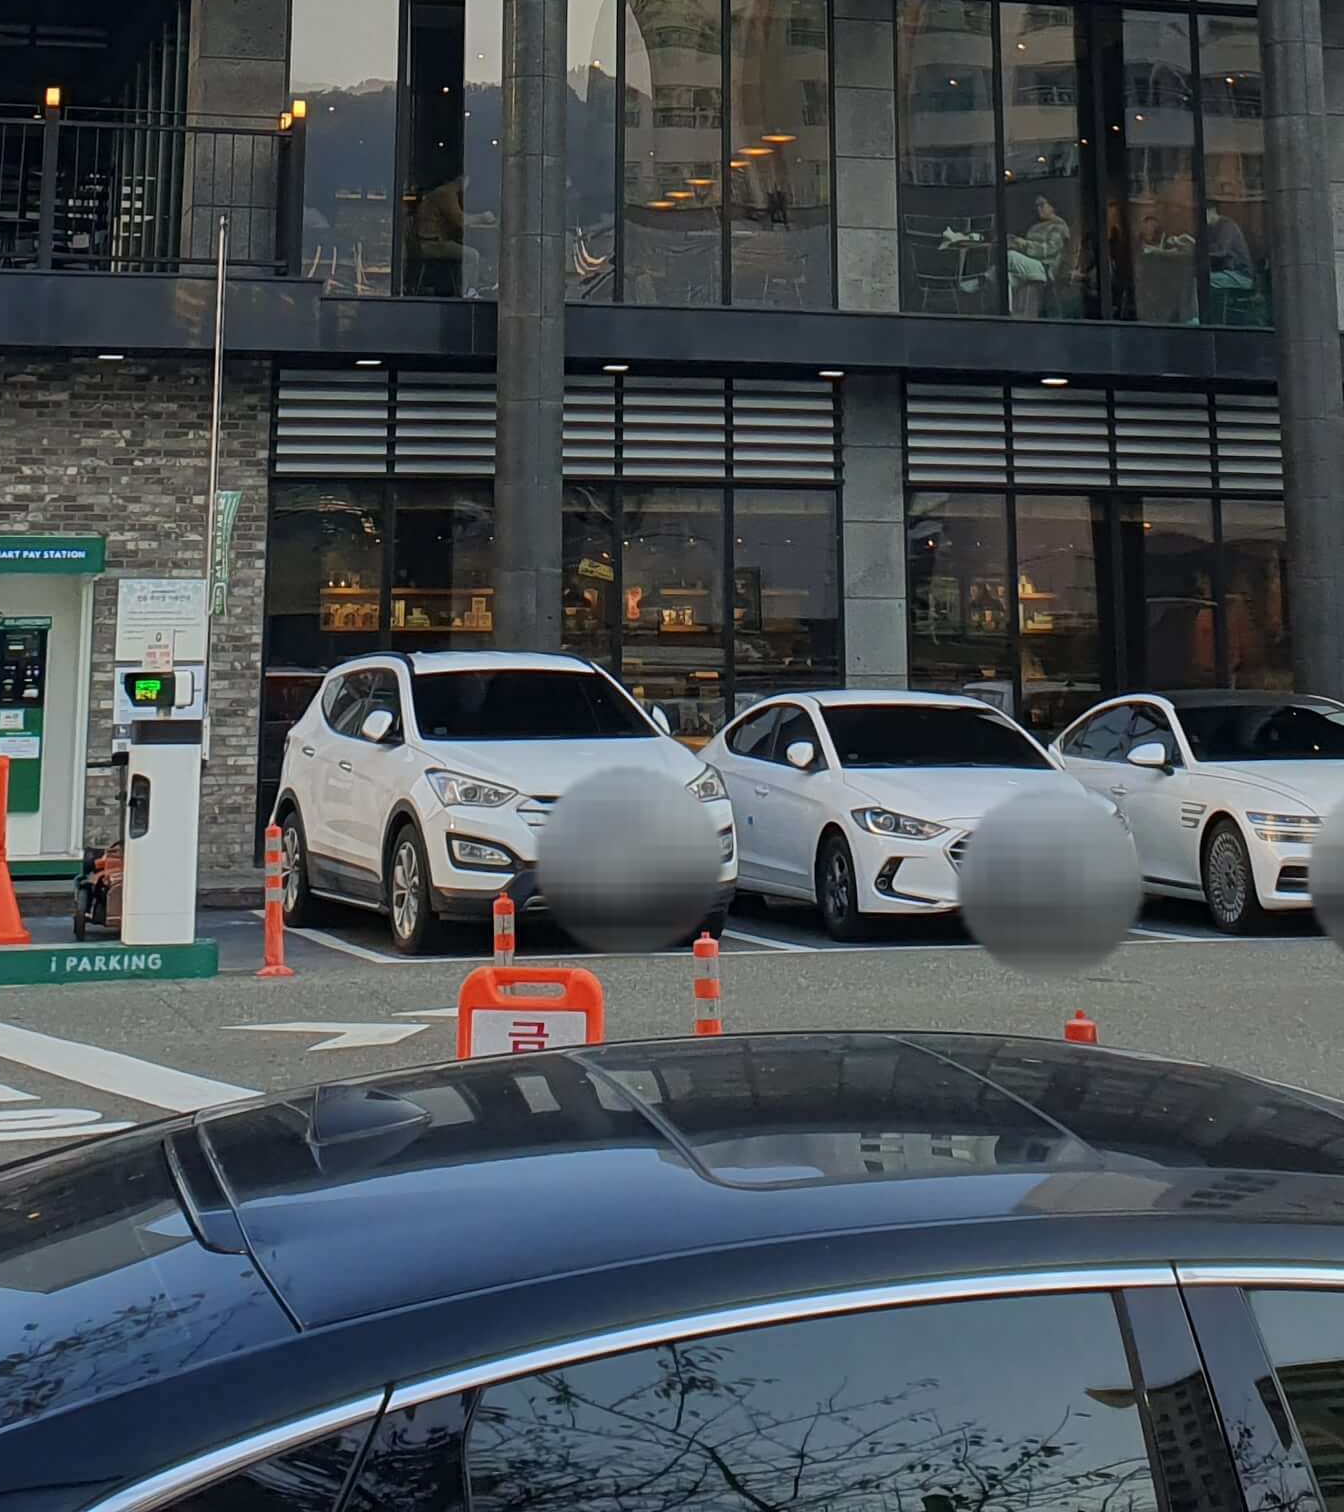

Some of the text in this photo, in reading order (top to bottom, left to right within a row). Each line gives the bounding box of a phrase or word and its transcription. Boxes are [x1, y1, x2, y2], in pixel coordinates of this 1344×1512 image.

[22, 550, 41, 559] PAY
[43, 550, 86, 559] STATION
[65, 953, 163, 972] PARKING
